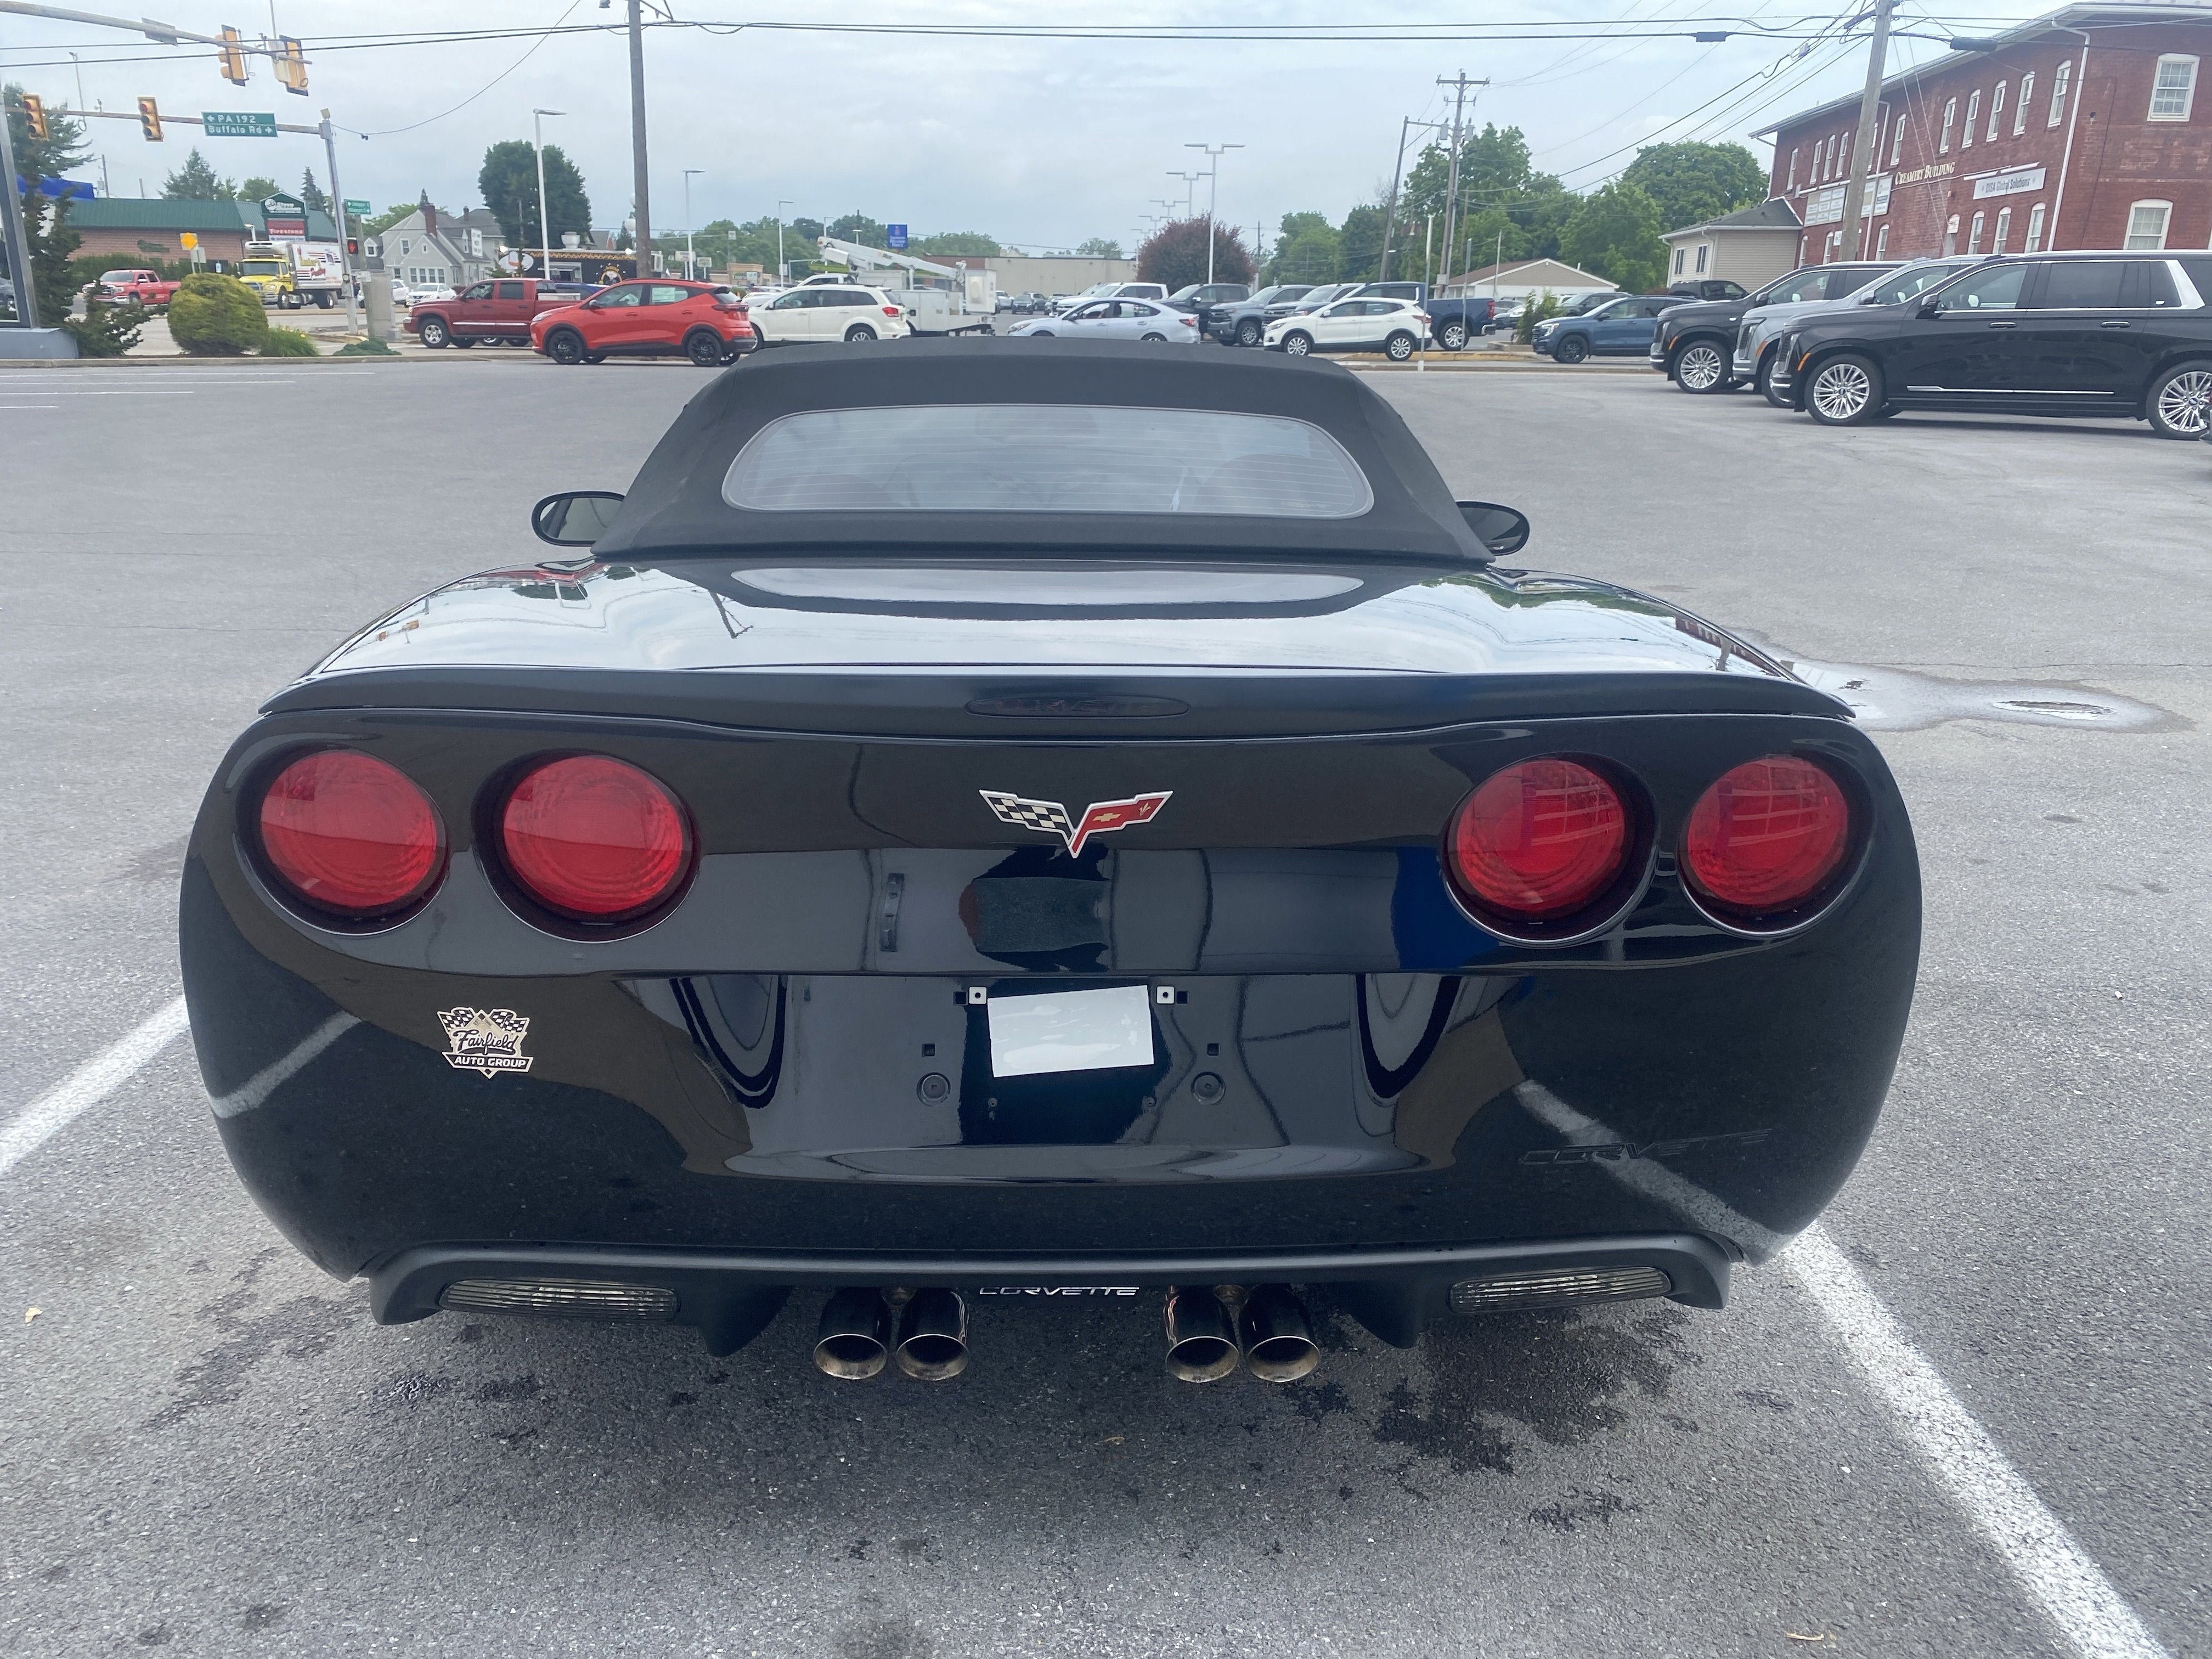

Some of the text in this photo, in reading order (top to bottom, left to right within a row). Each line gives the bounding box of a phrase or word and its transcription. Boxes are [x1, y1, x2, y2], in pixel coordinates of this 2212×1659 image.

[217, 114, 256, 123] PA 192
[208, 125, 262, 134] Buffalo Rd
[1895, 161, 1956, 185] CREAMERY BUILDING
[2010, 177, 2030, 189] Solutions
[453, 1029, 520, 1054] Fairfield
[454, 1056, 526, 1068] AUTO GROUP
[979, 1286, 1139, 1296] CORVETTE
